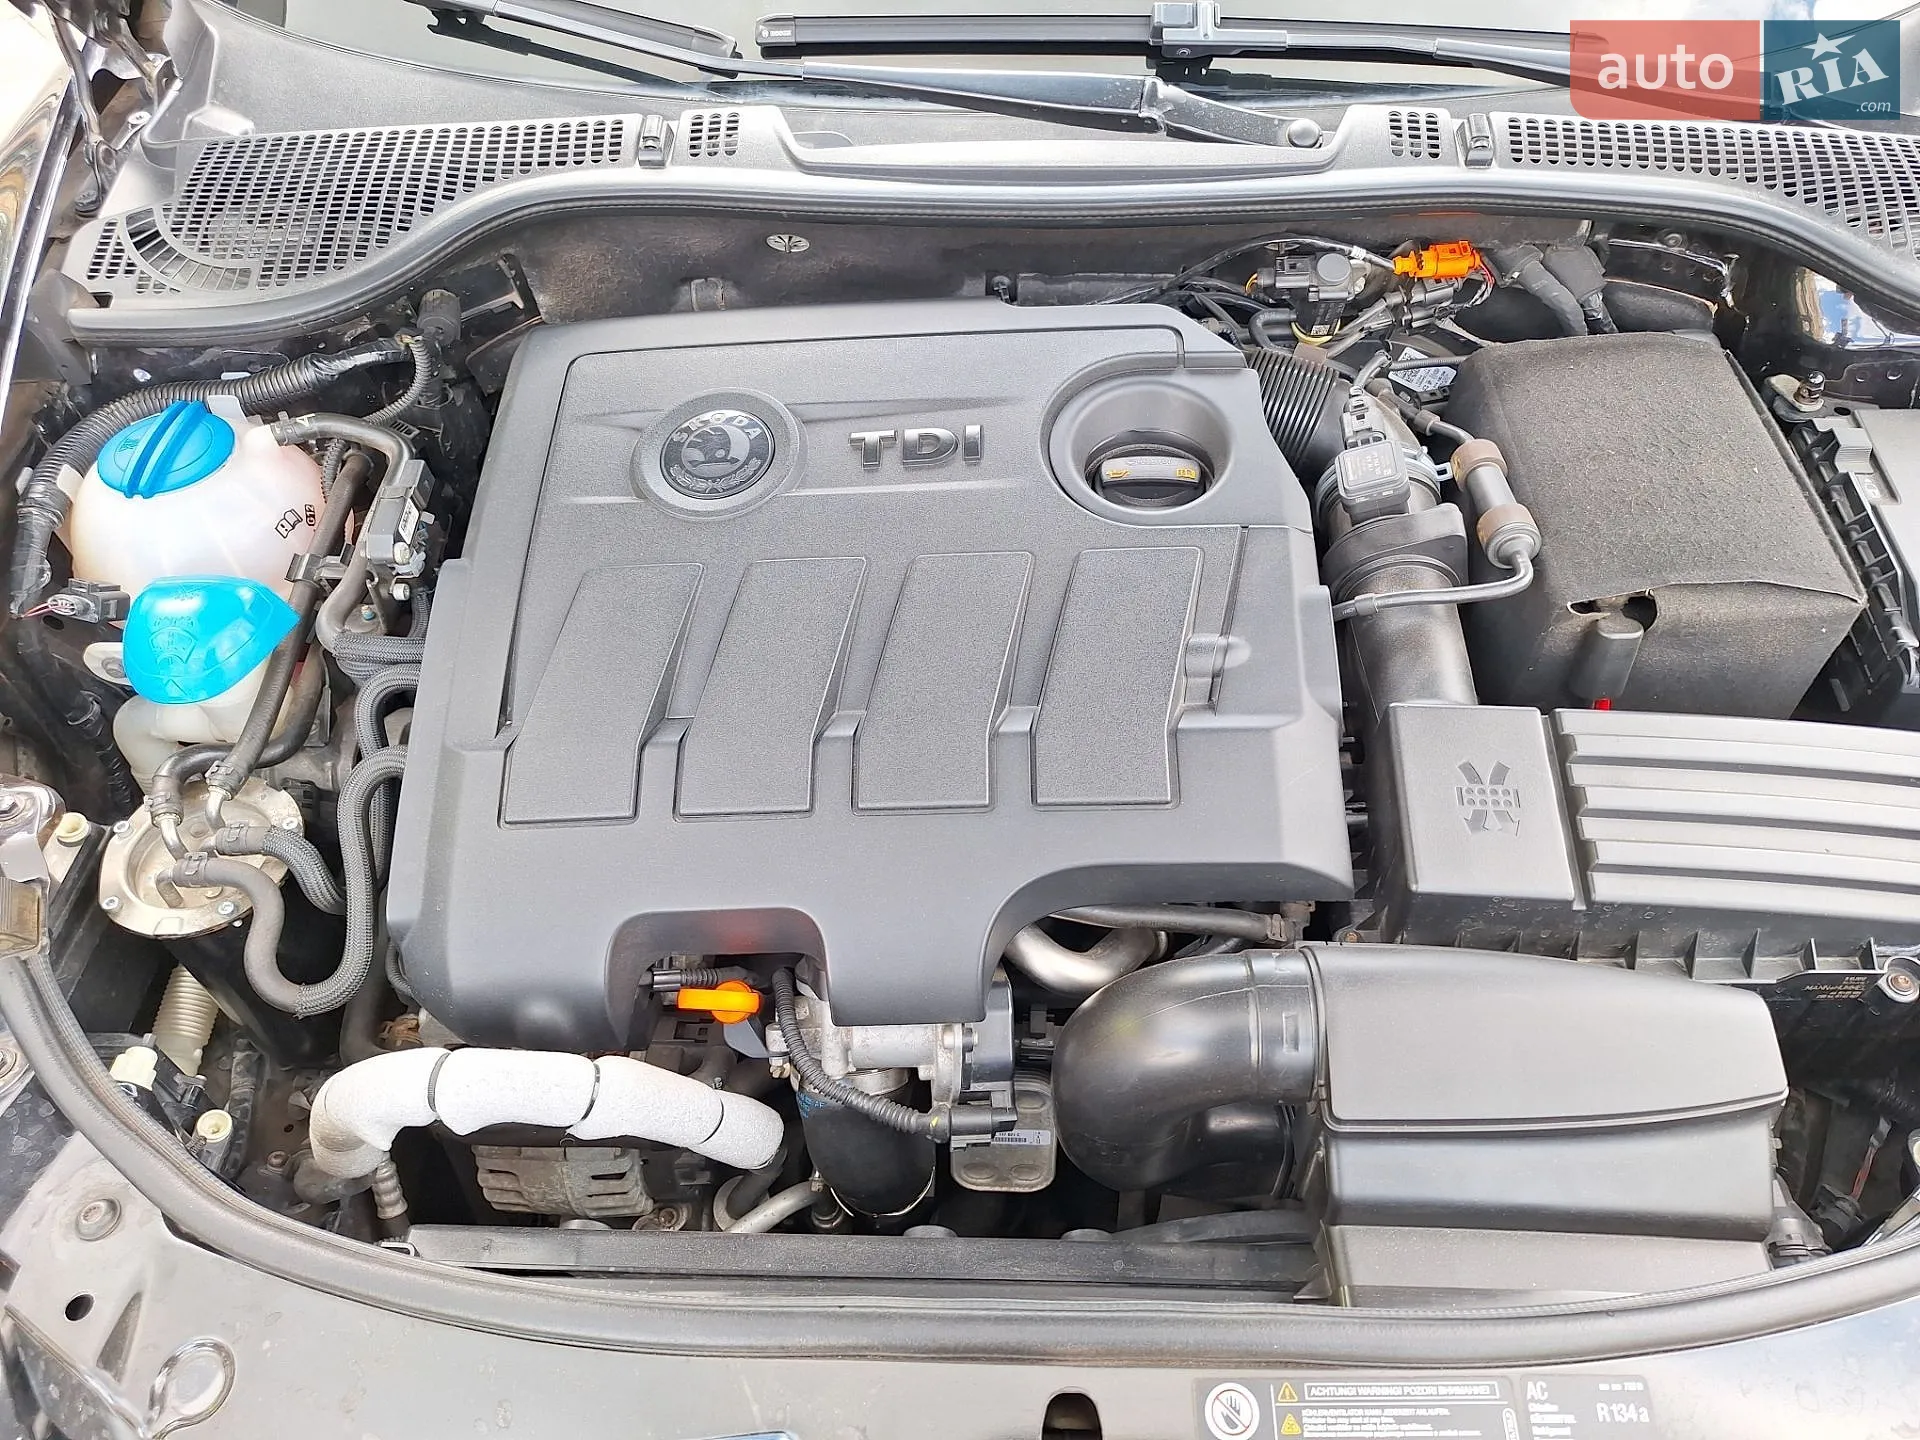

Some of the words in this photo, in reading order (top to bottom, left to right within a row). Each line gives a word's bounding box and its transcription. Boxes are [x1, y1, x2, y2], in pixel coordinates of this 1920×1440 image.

[849, 424, 984, 470] TDI
[305, 504, 315, 525] G12
[1527, 1381, 1548, 1400] AC
